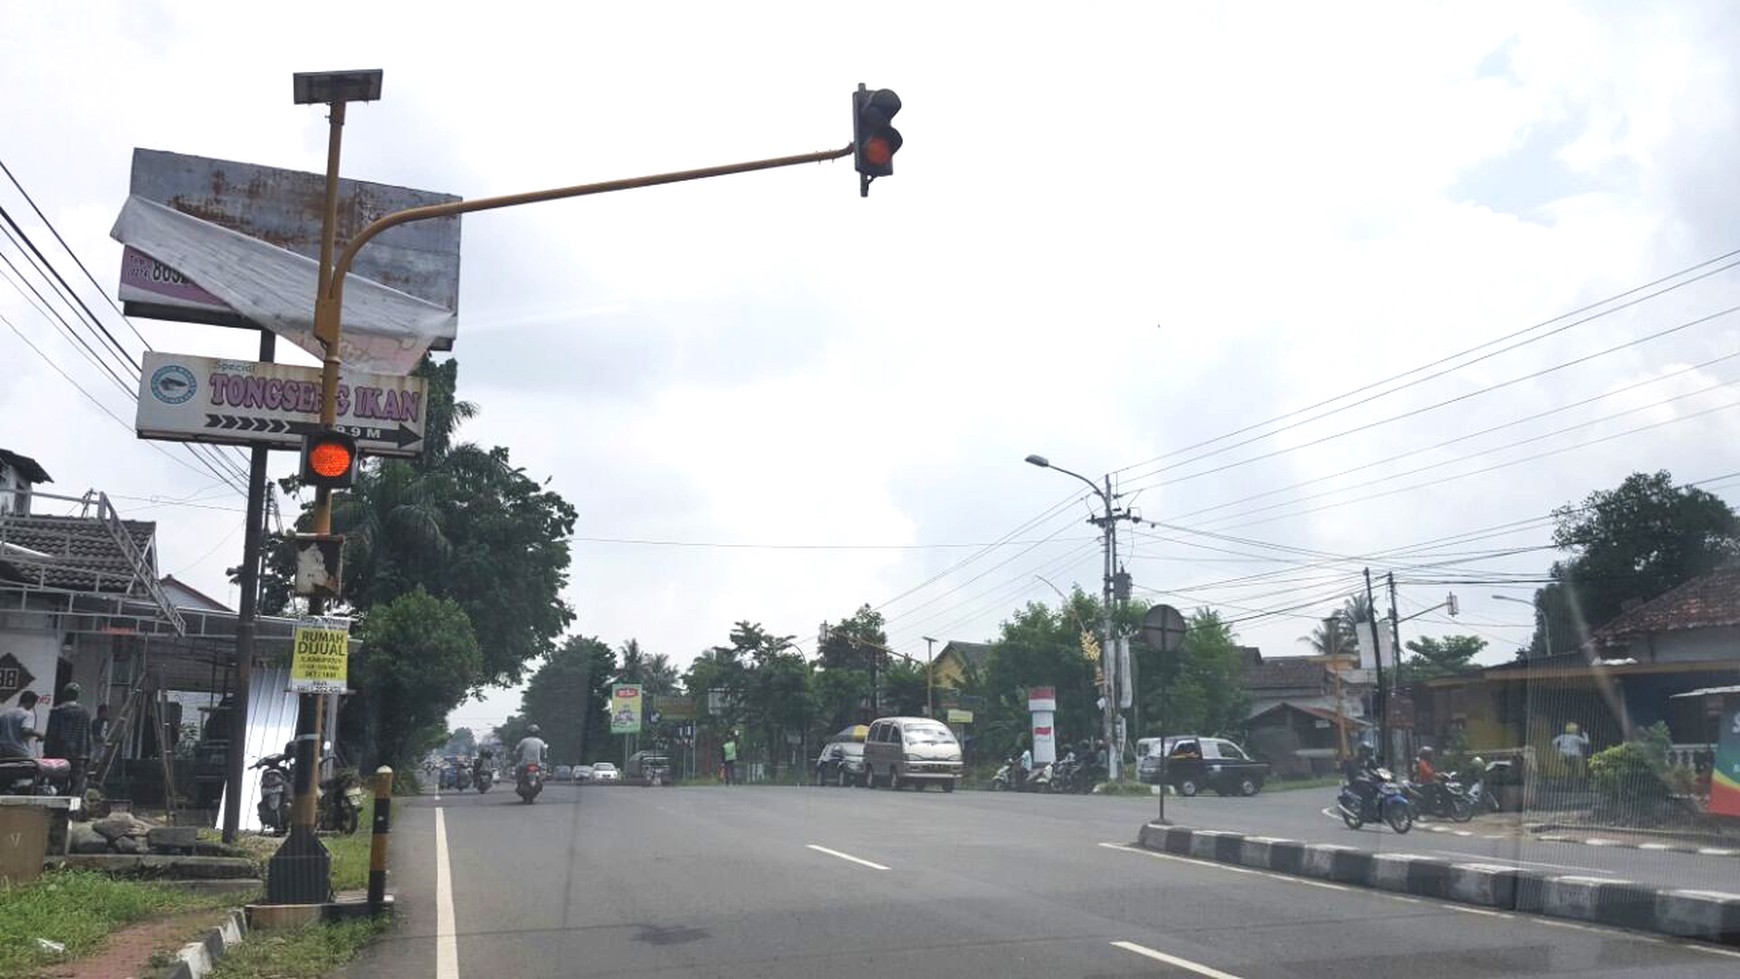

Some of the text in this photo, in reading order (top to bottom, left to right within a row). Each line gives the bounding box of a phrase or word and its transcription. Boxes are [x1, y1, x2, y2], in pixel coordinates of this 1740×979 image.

[209, 373, 350, 416] TONGSEG
[354, 386, 421, 422] IKAN
[302, 631, 344, 644] RUMAH
[298, 642, 346, 656] DIJUAL
